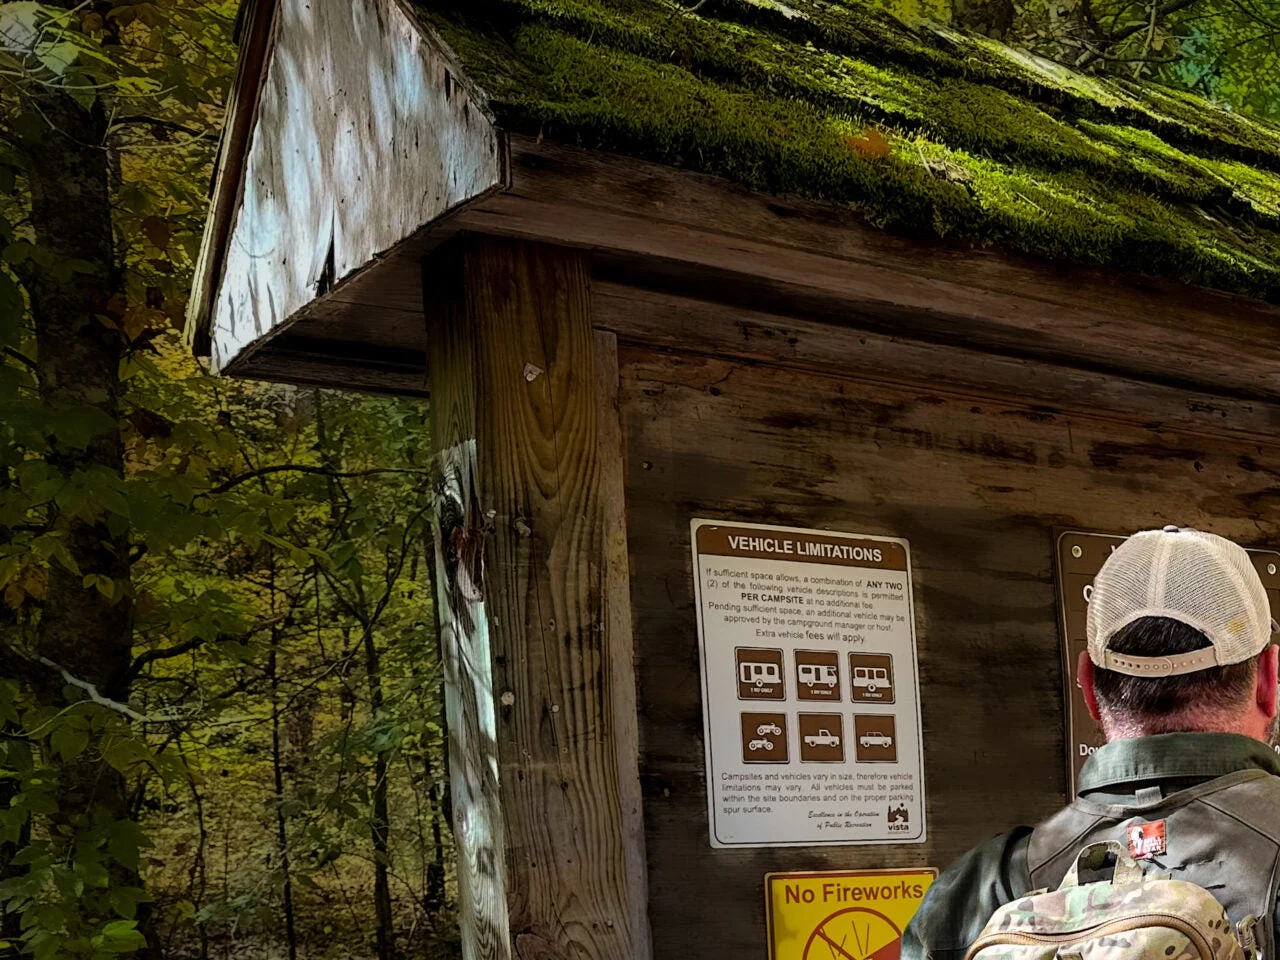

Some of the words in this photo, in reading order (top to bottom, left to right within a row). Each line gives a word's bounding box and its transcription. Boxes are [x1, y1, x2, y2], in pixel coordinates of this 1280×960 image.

[728, 536, 793, 554] VEHICLE
[797, 541, 882, 562] LIMITATIONS
[713, 568, 748, 578] sufficient
[750, 572, 773, 581] space
[810, 576, 853, 586] combination
[866, 580, 883, 589] ANY
[885, 582, 903, 590] TWO
[707, 579, 719, 590] (2)
[733, 581, 746, 589] the
[750, 582, 783, 593] following
[787, 585, 812, 594] vehicle
[816, 587, 859, 597] descriptions
[871, 592, 903, 601] permitted
[741, 592, 759, 601] PER
[761, 594, 804, 604] CAMPSITE
[826, 599, 860, 608] additional
[708, 601, 741, 613] Pending
[743, 604, 777, 613] sufficient
[817, 609, 852, 618] additional
[853, 612, 878, 620] vehicle
[879, 614, 894, 623] may
[895, 614, 905, 622] be
[724, 615, 760, 624] approved
[762, 616, 771, 625] by
[773, 617, 785, 625] the
[787, 618, 833, 628] campground
[834, 621, 865, 631] manager
[755, 628, 776, 638] Extra
[777, 630, 804, 639] vehicle
[805, 630, 825, 640] fees
[827, 632, 840, 641] will
[721, 772, 762, 782] Campsites
[764, 773, 779, 781] and
[780, 773, 811, 781] vehicles
[813, 774, 828, 782] vary
[856, 772, 887, 780] therefore
[889, 772, 913, 780] vehicle
[765, 784, 781, 792] may
[811, 783, 820, 791] All
[824, 783, 853, 791] vehicles
[857, 783, 874, 791] must
[878, 783, 886, 791] be
[890, 783, 913, 792] parked
[722, 794, 745, 802] within
[748, 794, 760, 802] the
[763, 794, 777, 802] site
[779, 794, 820, 802] boundaries
[864, 794, 887, 803] proper
[889, 794, 914, 803] parking
[723, 806, 740, 816] spur
[888, 823, 909, 831] vista
[785, 885, 815, 904] No
[822, 880, 924, 903] Fireworks
